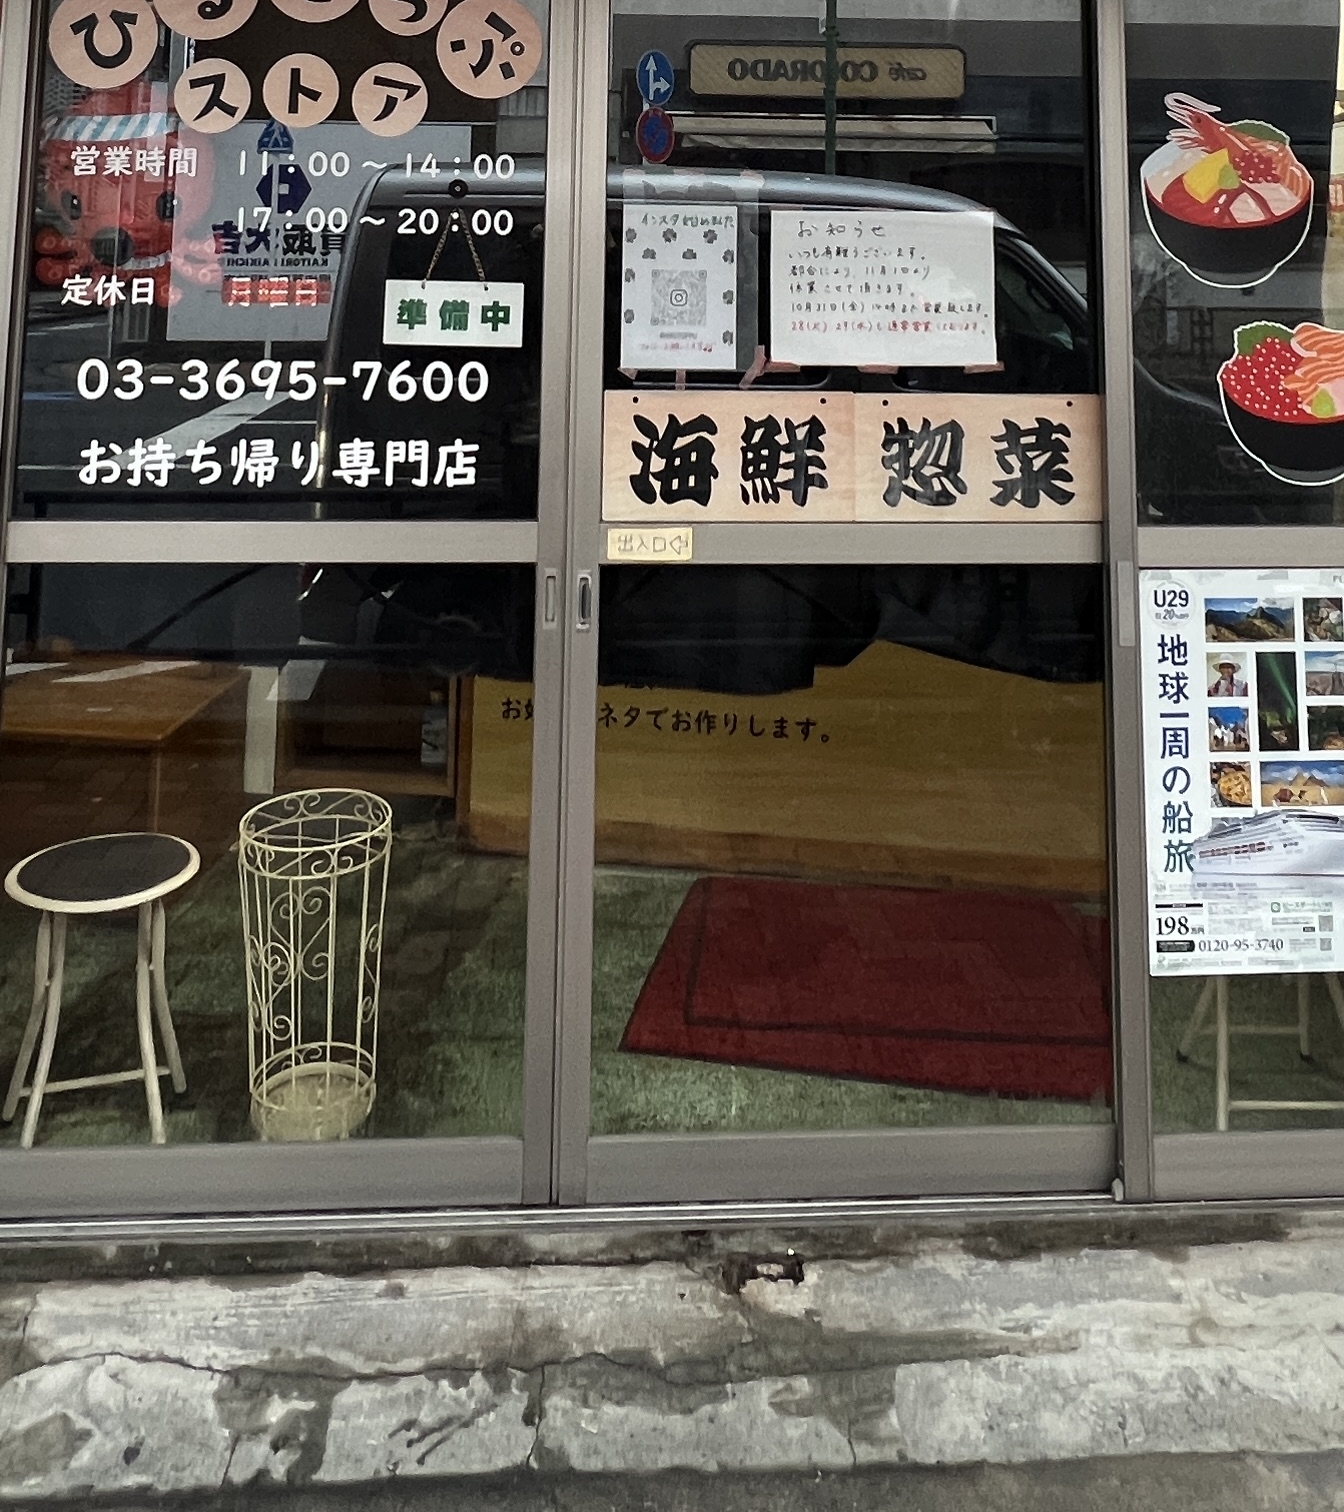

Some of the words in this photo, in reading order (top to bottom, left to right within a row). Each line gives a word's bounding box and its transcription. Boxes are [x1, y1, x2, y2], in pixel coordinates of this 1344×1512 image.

[190, 68, 422, 122] ストア
[71, 146, 198, 178] 営業時間
[61, 275, 155, 306] 定休日
[228, 277, 317, 306] 月曜日
[396, 297, 512, 332] 準備中
[76, 358, 489, 403] 03-3695-7600
[78, 438, 480, 488] お持ち帰り専門店
[630, 413, 829, 508] 海鮮
[881, 416, 1077, 509] 惣菜
[618, 534, 666, 553] 出入口
[1153, 589, 1189, 607] U29
[1157, 633, 1196, 874] 地球一周の船旅
[1198, 938, 1284, 952] 0120-95-3740
